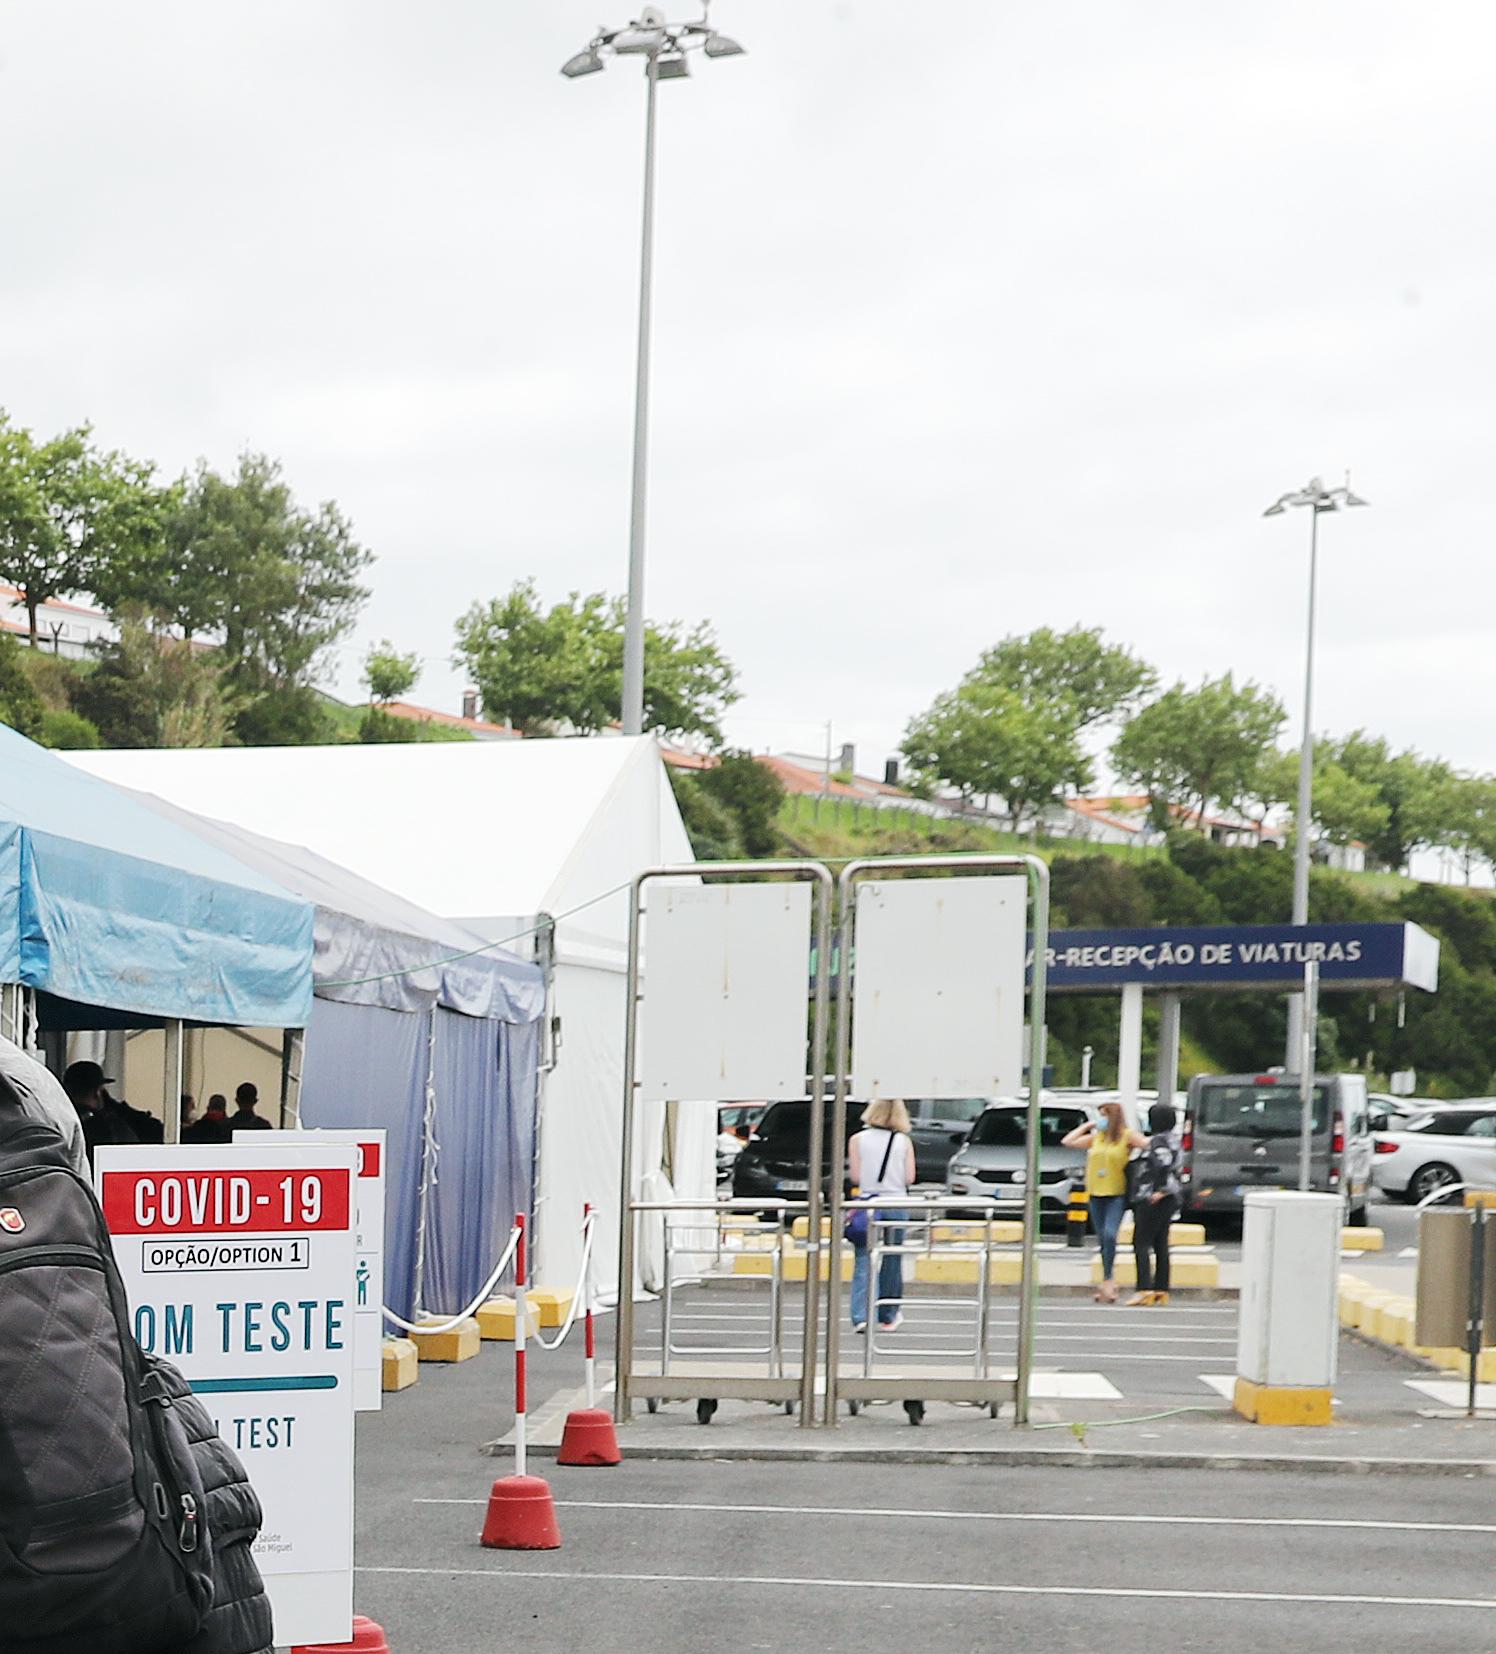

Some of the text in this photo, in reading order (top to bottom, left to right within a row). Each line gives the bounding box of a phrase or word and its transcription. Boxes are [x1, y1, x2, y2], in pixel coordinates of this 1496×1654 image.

[1200, 943, 1233, 964] DE
[1238, 940, 1362, 964] VIATURAS
[134, 1175, 323, 1227] COVID-19
[150, 1241, 302, 1268] OPÇÃO/OPTION 1
[134, 1300, 345, 1355] OM TESTE
[232, 1416, 296, 1450] TEST
